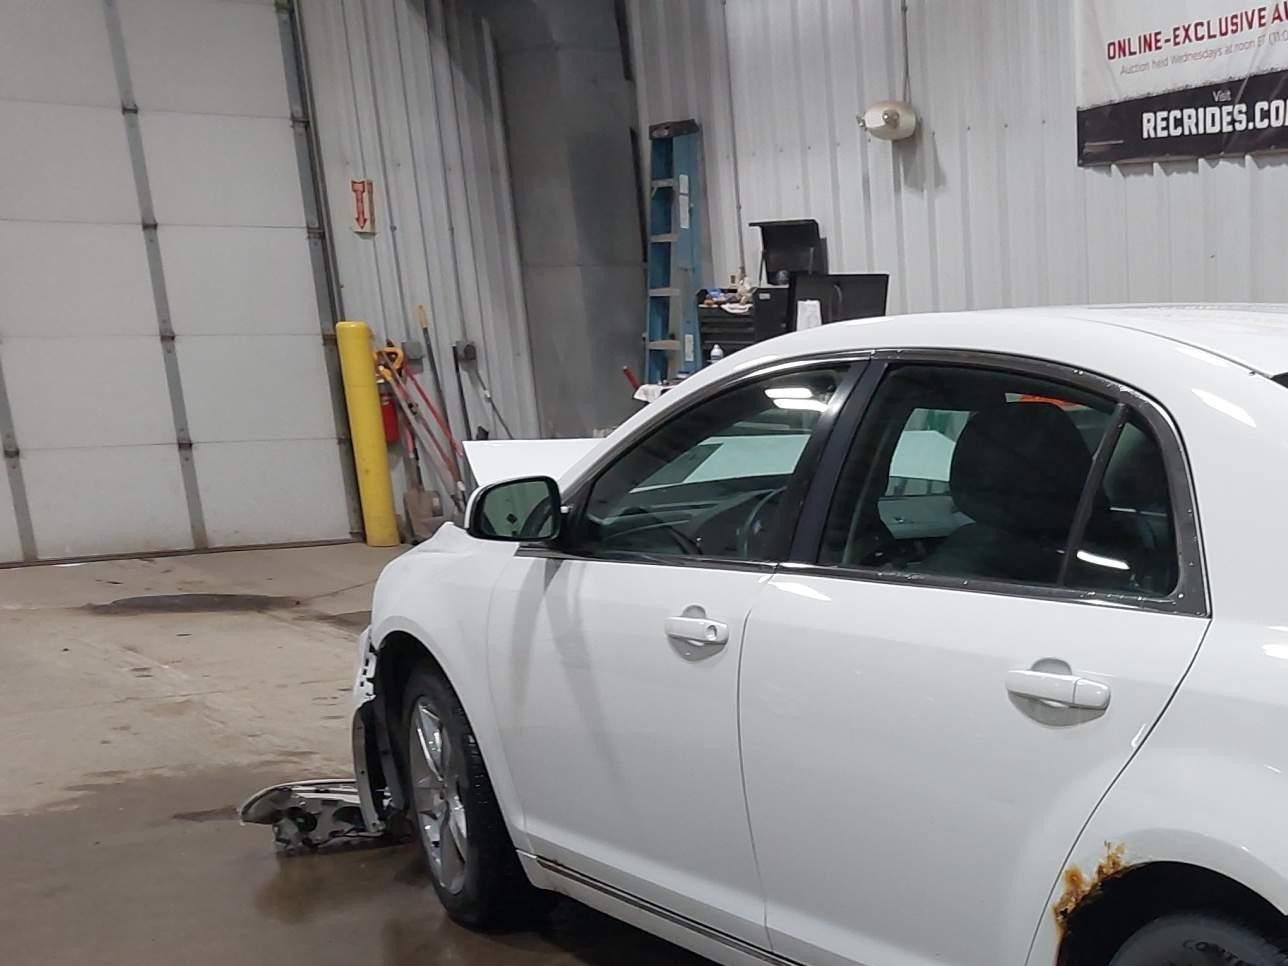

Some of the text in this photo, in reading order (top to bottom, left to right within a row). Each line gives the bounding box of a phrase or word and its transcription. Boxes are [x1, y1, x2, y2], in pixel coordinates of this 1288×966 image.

[1106, 6, 1267, 61] ONLINE-EXCLUSIVE
[1119, 61, 1150, 76] Auction
[1151, 56, 1169, 68] held
[1170, 47, 1223, 64] Wednesdays
[1212, 89, 1232, 103] Visit
